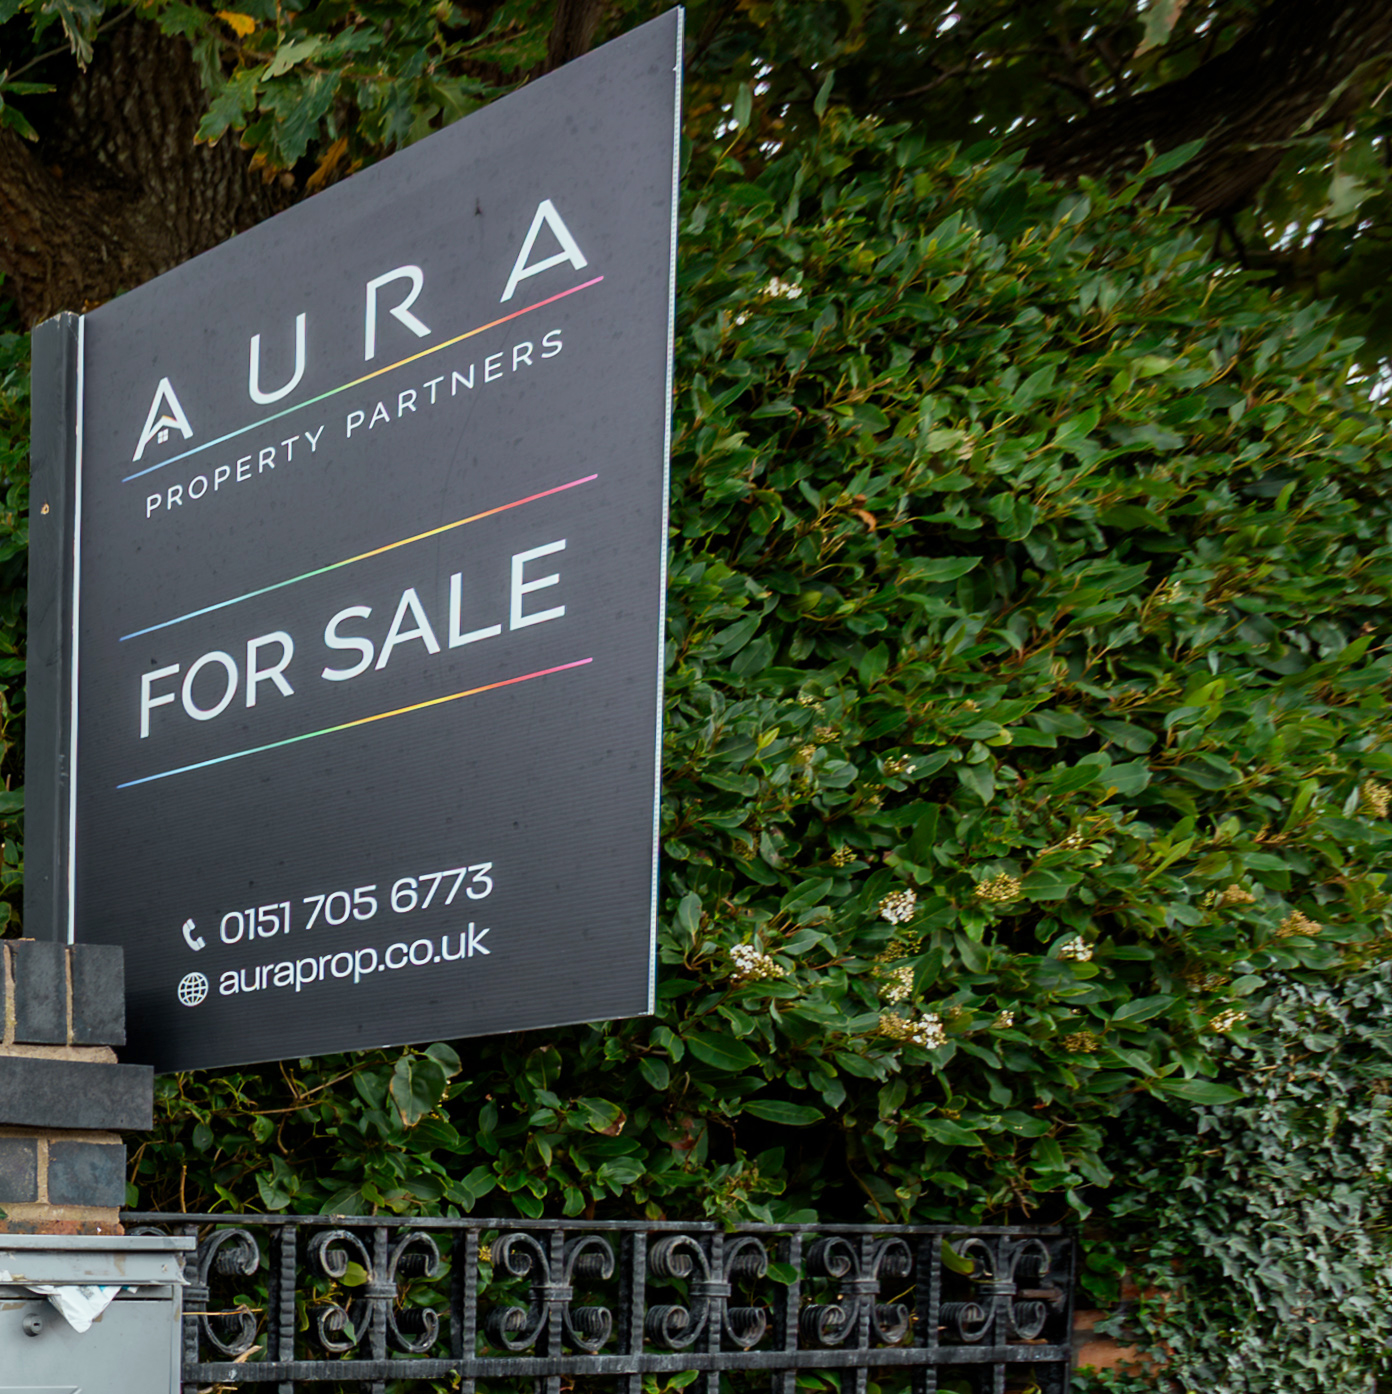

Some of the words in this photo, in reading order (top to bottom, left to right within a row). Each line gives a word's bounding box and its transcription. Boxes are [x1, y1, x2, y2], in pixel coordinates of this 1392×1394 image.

[132, 198, 589, 462] AURA
[145, 424, 325, 519] PROPERTY
[346, 328, 564, 439] PARTNERS
[139, 630, 295, 739] FOR
[321, 538, 567, 682] SALE
[219, 901, 292, 945] 0151
[302, 884, 379, 931] 705
[390, 861, 494, 913] 6773
[219, 921, 492, 996] auraprop.co.uk
